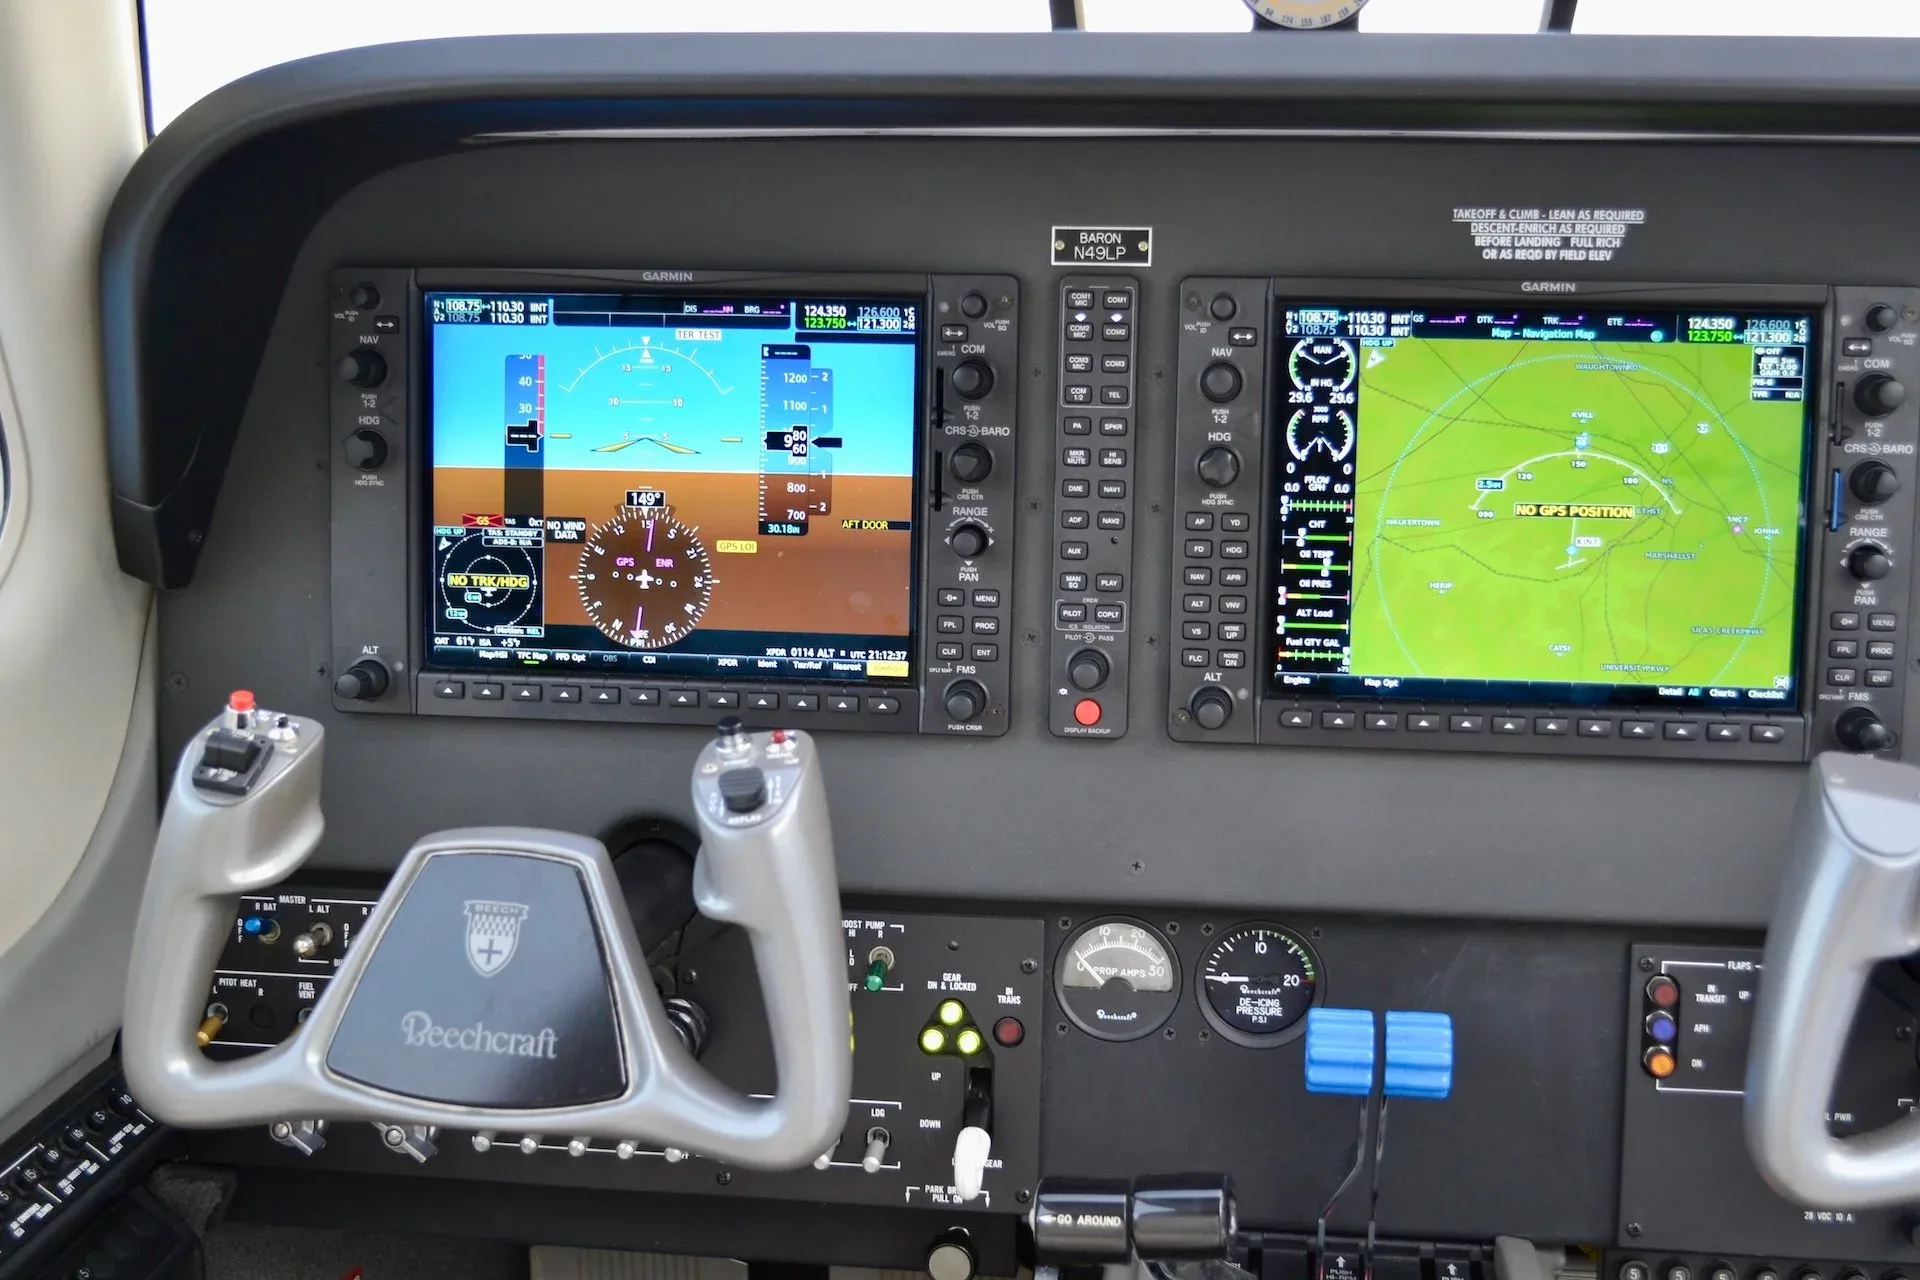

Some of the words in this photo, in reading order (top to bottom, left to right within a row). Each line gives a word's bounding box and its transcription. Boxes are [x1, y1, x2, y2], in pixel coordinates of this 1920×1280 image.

[1453, 209, 1496, 219] TAKEOFF
[1499, 211, 1506, 219] &
[1509, 210, 1539, 220] CLIMB
[1549, 211, 1575, 220] LEAN
[1577, 211, 1590, 220] AS
[1593, 211, 1644, 221] REQUIRED
[1471, 223, 1556, 234] DESCENT-ENRICH
[1559, 224, 1572, 234] AS
[1575, 224, 1624, 234] REQUIRED
[1080, 233, 1121, 244] BARON
[1475, 236, 1511, 247] BEFORE
[1514, 237, 1560, 247] LANDING
[1570, 237, 1593, 247] FULL
[1596, 238, 1620, 248] RICH
[1074, 246, 1126, 260] N49LP
[1482, 250, 1497, 259] OR
[1499, 250, 1512, 259] AS
[1545, 250, 1558, 260] BY
[1560, 251, 1585, 261] FIELD
[1589, 251, 1611, 261] ELEV
[643, 272, 692, 281] GARMIN
[1522, 282, 1575, 292] GARMIN
[448, 302, 480, 311] 108.75
[491, 302, 524, 312] 110.30
[804, 306, 846, 316] 124.350
[858, 307, 900, 317] 126.600
[448, 313, 480, 323] 108.75
[491, 314, 524, 324] 110.30
[1301, 312, 1336, 323] 108.75
[1348, 313, 1384, 324] 110.30
[805, 318, 846, 327] 123.750
[859, 319, 899, 329] 121.300
[1688, 318, 1732, 329] 124.350
[1746, 320, 1790, 330] 126.600
[699, 331, 720, 339] TEST
[1301, 325, 1336, 335] 108.75
[1348, 326, 1384, 336] 110.30
[1492, 328, 1511, 339] Map
[1523, 328, 1573, 339] Navigation
[1575, 330, 1594, 340] Map
[360, 335, 379, 344] NAV
[1688, 331, 1732, 341] 123.750
[1746, 332, 1789, 342] 121.300
[961, 345, 985, 354] COM
[1212, 348, 1232, 357] NAV
[1864, 360, 1889, 368] COM
[519, 377, 532, 386] 40
[783, 373, 807, 383] 1200
[1289, 392, 1313, 403] 29.6
[1329, 394, 1353, 404] 29.6
[518, 402, 532, 415] 30
[783, 400, 807, 411] 1100
[359, 416, 379, 424] HDG
[945, 426, 966, 435] CRS
[982, 426, 1010, 436] BARO
[1208, 432, 1231, 441] HDG
[1844, 444, 1867, 453] CRS
[1883, 444, 1913, 454] BARO
[787, 482, 806, 492] 800
[632, 493, 660, 505] 149°
[787, 510, 805, 520] 700
[953, 507, 988, 516] RANGE
[1516, 505, 1536, 516] NO
[1539, 505, 1566, 517] GPS
[1569, 506, 1632, 517] POSITION
[476, 517, 489, 525] GS
[842, 521, 859, 529] AFT
[863, 521, 888, 529] DOOR
[1386, 518, 1440, 526] WALKERTOWN
[547, 521, 560, 530] NO
[563, 522, 585, 531] WIND
[555, 531, 578, 539] DATA
[1850, 529, 1888, 537] RANGE
[617, 558, 634, 566] GPS
[656, 559, 673, 568] ENR
[450, 576, 467, 585] NO
[471, 576, 527, 587] TRK/HDG
[959, 573, 979, 581] PAN
[362, 646, 378, 654] ALT
[791, 648, 814, 657] 0114
[817, 649, 835, 658] ALT
[868, 651, 907, 660] 21:12:37
[957, 666, 975, 674] FMS
[1204, 673, 1222, 681] ALT
[279, 896, 306, 904] MASTER
[475, 904, 519, 914] BEECH
[866, 921, 885, 929] PUMP
[849, 929, 855, 937] HI
[1099, 926, 1110, 936] 10
[1131, 929, 1145, 938] 20
[1255, 943, 1266, 952] 10
[1077, 962, 1085, 971] 0
[1728, 962, 1751, 970] FLAPS
[1093, 967, 1118, 976] PROP
[1120, 968, 1145, 977] AMPS
[1148, 966, 1164, 977] 30
[943, 973, 961, 982] GEAR
[1283, 975, 1299, 986] 20
[950, 982, 976, 991] LOCKED
[998, 995, 1020, 1004] TRANS
[1696, 994, 1725, 1003] TRANSIT
[1739, 991, 1749, 999] UP
[1239, 998, 1279, 1007] DE-ICING
[1236, 1007, 1282, 1016] PRESSURE
[1694, 1024, 1709, 1033] APH
[402, 1010, 557, 1059] Beechcraft
[931, 1072, 941, 1080] UP
[871, 1109, 884, 1117] LDG
[1834, 1113, 1851, 1121] PWR
[920, 1120, 940, 1128] DOWN
[985, 1159, 1002, 1168] GEAR
[925, 1185, 944, 1193] PARK
[932, 1194, 950, 1202] PULL
[952, 1195, 962, 1203] ON
[1058, 1215, 1071, 1224] GO
[1077, 1216, 1121, 1225] AROUND
[1804, 1212, 1814, 1220] 28
[1817, 1212, 1831, 1221] VDC
[1836, 1213, 1843, 1221] 10
